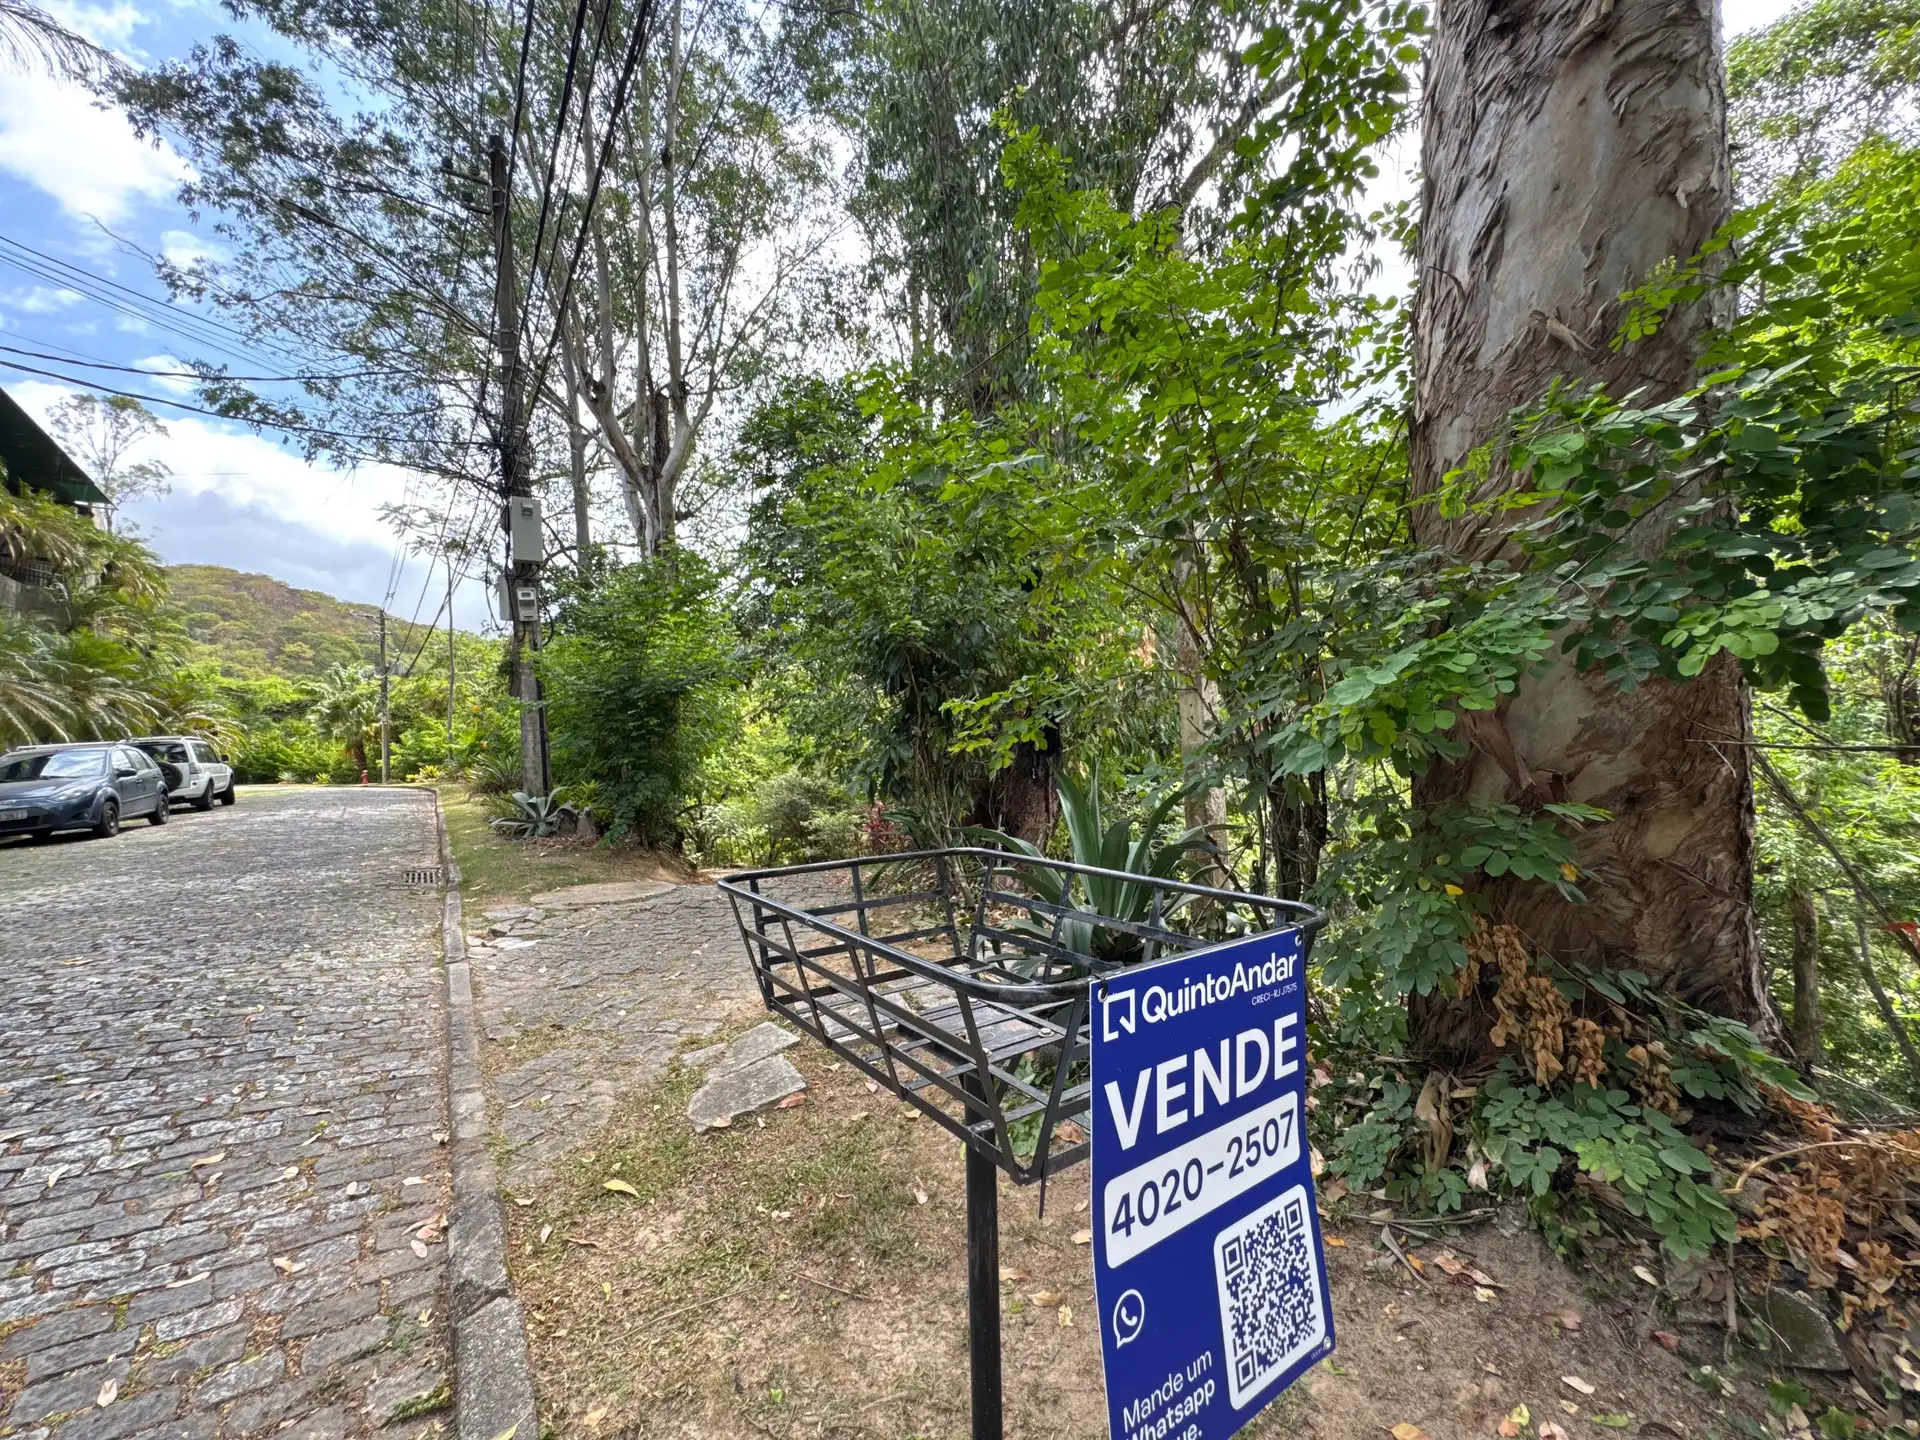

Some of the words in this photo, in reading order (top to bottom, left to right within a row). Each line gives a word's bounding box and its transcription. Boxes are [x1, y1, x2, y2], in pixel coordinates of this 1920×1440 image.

[1141, 952, 1298, 1024] QuintoAndar
[1103, 1011, 1299, 1151] VENDE
[1111, 1108, 1295, 1238] 4020-2507
[1123, 1372, 1184, 1433] Mande
[1187, 1350, 1213, 1382] um
